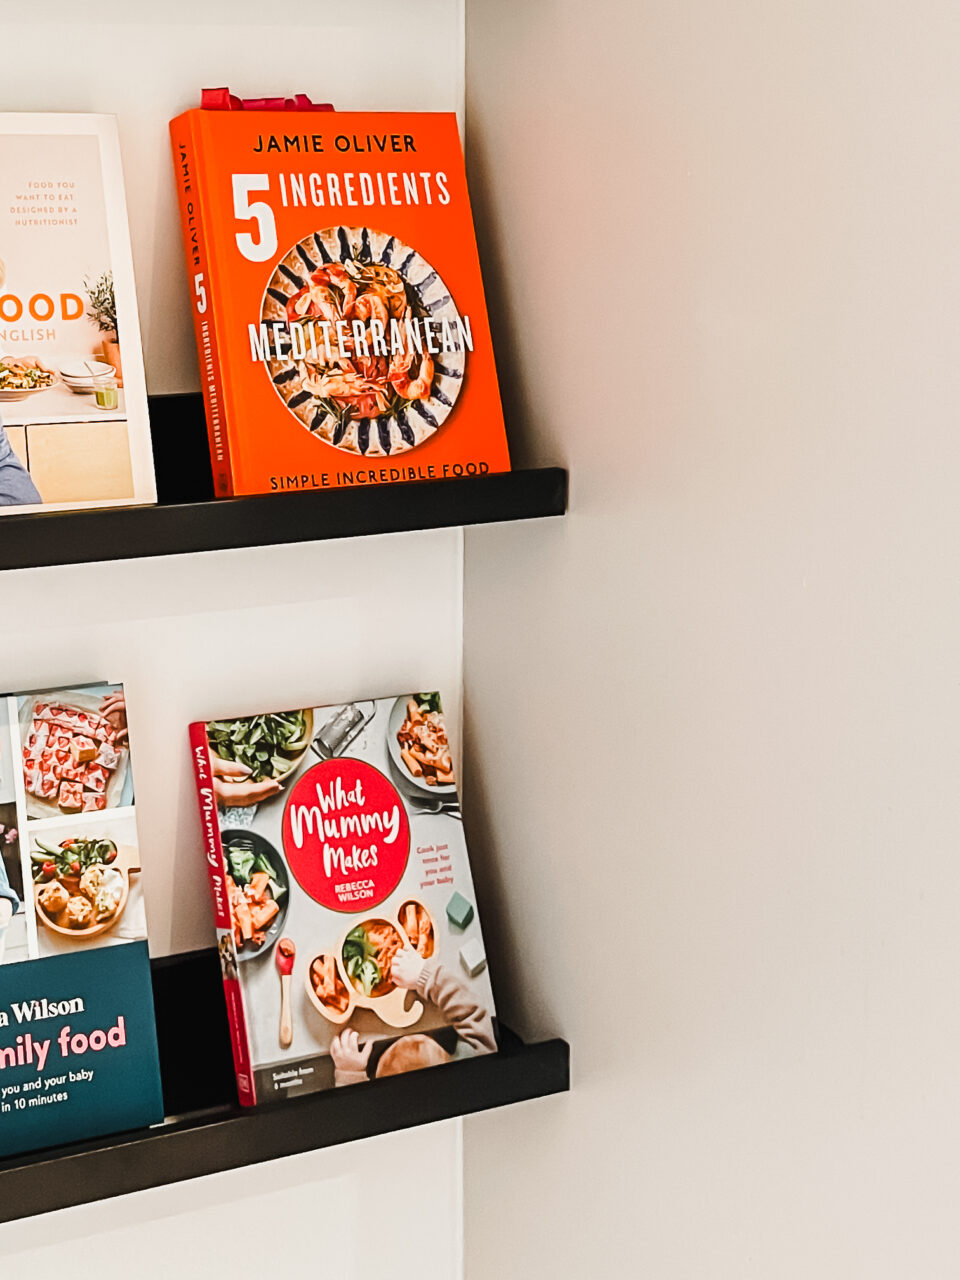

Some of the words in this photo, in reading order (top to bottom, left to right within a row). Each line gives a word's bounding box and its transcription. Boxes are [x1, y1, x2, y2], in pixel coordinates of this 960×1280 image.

[254, 134, 324, 153] JAMIE
[335, 134, 417, 153] OLIVER
[179, 144, 191, 193] JAMIE
[188, 202, 200, 266] OLIVER
[195, 272, 207, 314] 5
[231, 173, 278, 263] 5
[279, 171, 451, 208] INGREDIENTS
[248, 314, 475, 363] MEDITERRANEAN
[270, 473, 330, 491] SIMPLE
[337, 466, 435, 486] INCREDIBLE
[443, 462, 490, 477] FOOD
[195, 746, 207, 780] What
[316, 776, 365, 813] What
[200, 788, 218, 867] Mummy
[291, 804, 400, 849] Mummy
[323, 843, 378, 877] Makes
[335, 879, 375, 894] REBECCA
[338, 889, 373, 902] WILSON
[10, 997, 84, 1024] Wilson
[58, 1016, 126, 1057] food
[2, 1085, 20, 1099] you
[23, 1077, 41, 1092] and
[44, 1077, 67, 1092] your
[69, 1068, 94, 1082] baby
[2, 1102, 10, 1112] in
[14, 1098, 25, 1110] 10
[28, 1091, 68, 1107] minutes
